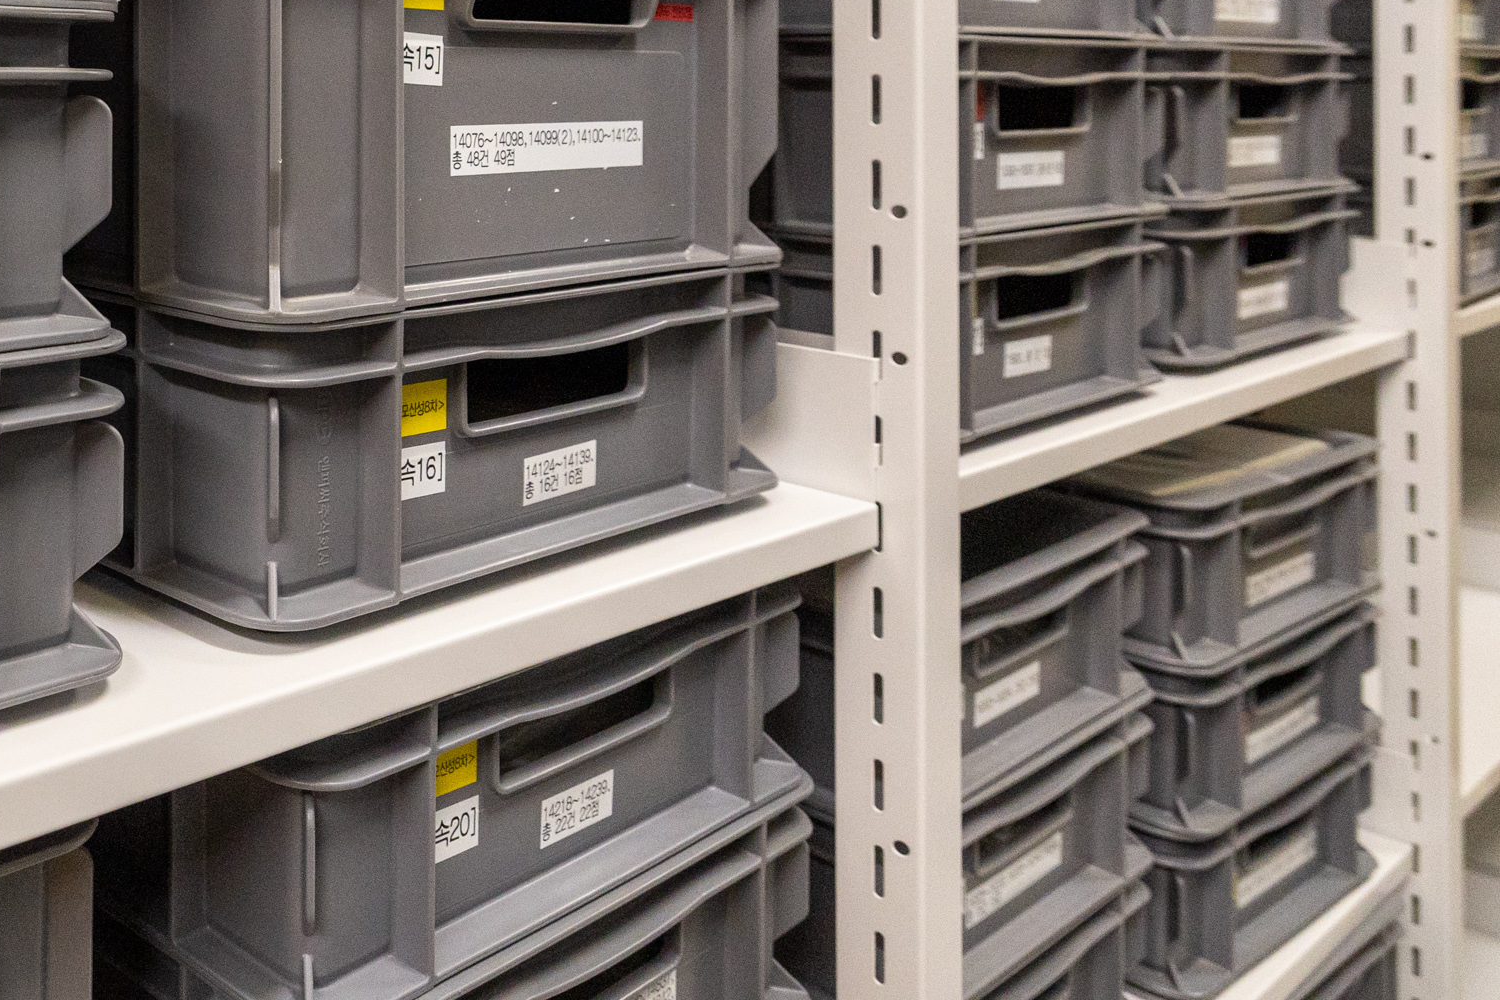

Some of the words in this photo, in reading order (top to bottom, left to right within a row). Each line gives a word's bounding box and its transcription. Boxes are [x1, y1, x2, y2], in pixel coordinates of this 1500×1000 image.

[452, 151, 462, 171] 총
[466, 151, 489, 169] 48건
[493, 148, 516, 167] 49점
[525, 481, 535, 500] 총
[539, 473, 559, 493] 16건
[564, 467, 583, 486] 16점
[542, 822, 552, 842] 총
[555, 810, 576, 834] 22건
[579, 799, 599, 822] 22점
